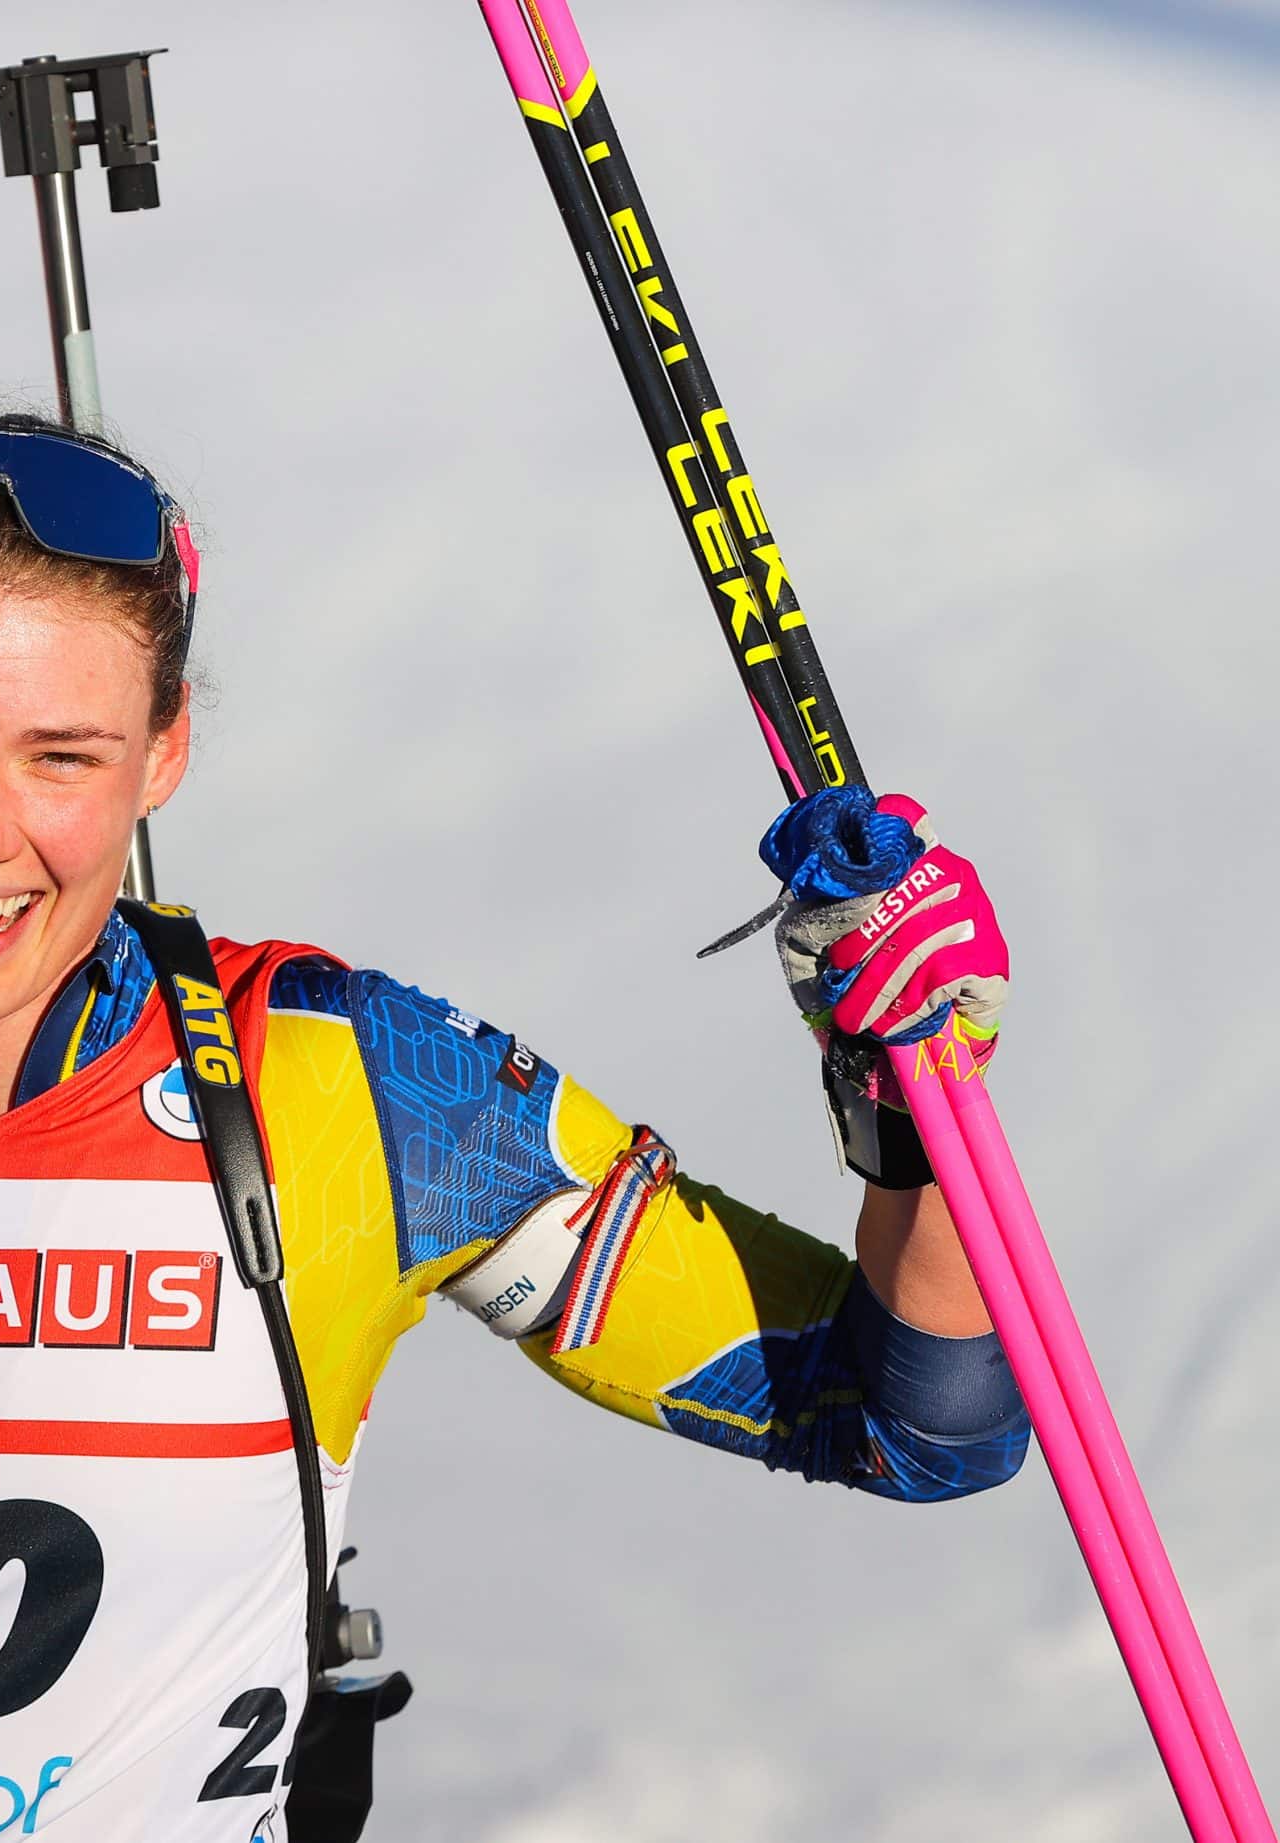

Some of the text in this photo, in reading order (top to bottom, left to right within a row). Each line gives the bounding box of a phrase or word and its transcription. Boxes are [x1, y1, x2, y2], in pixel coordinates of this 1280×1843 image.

[667, 440, 781, 667] LEKI
[701, 406, 808, 632] LEKI
[859, 862, 945, 941] HESTRA
[175, 974, 242, 1087] ATG
[480, 1274, 537, 1323] ARSEN
[197, 1687, 297, 1802] 2
